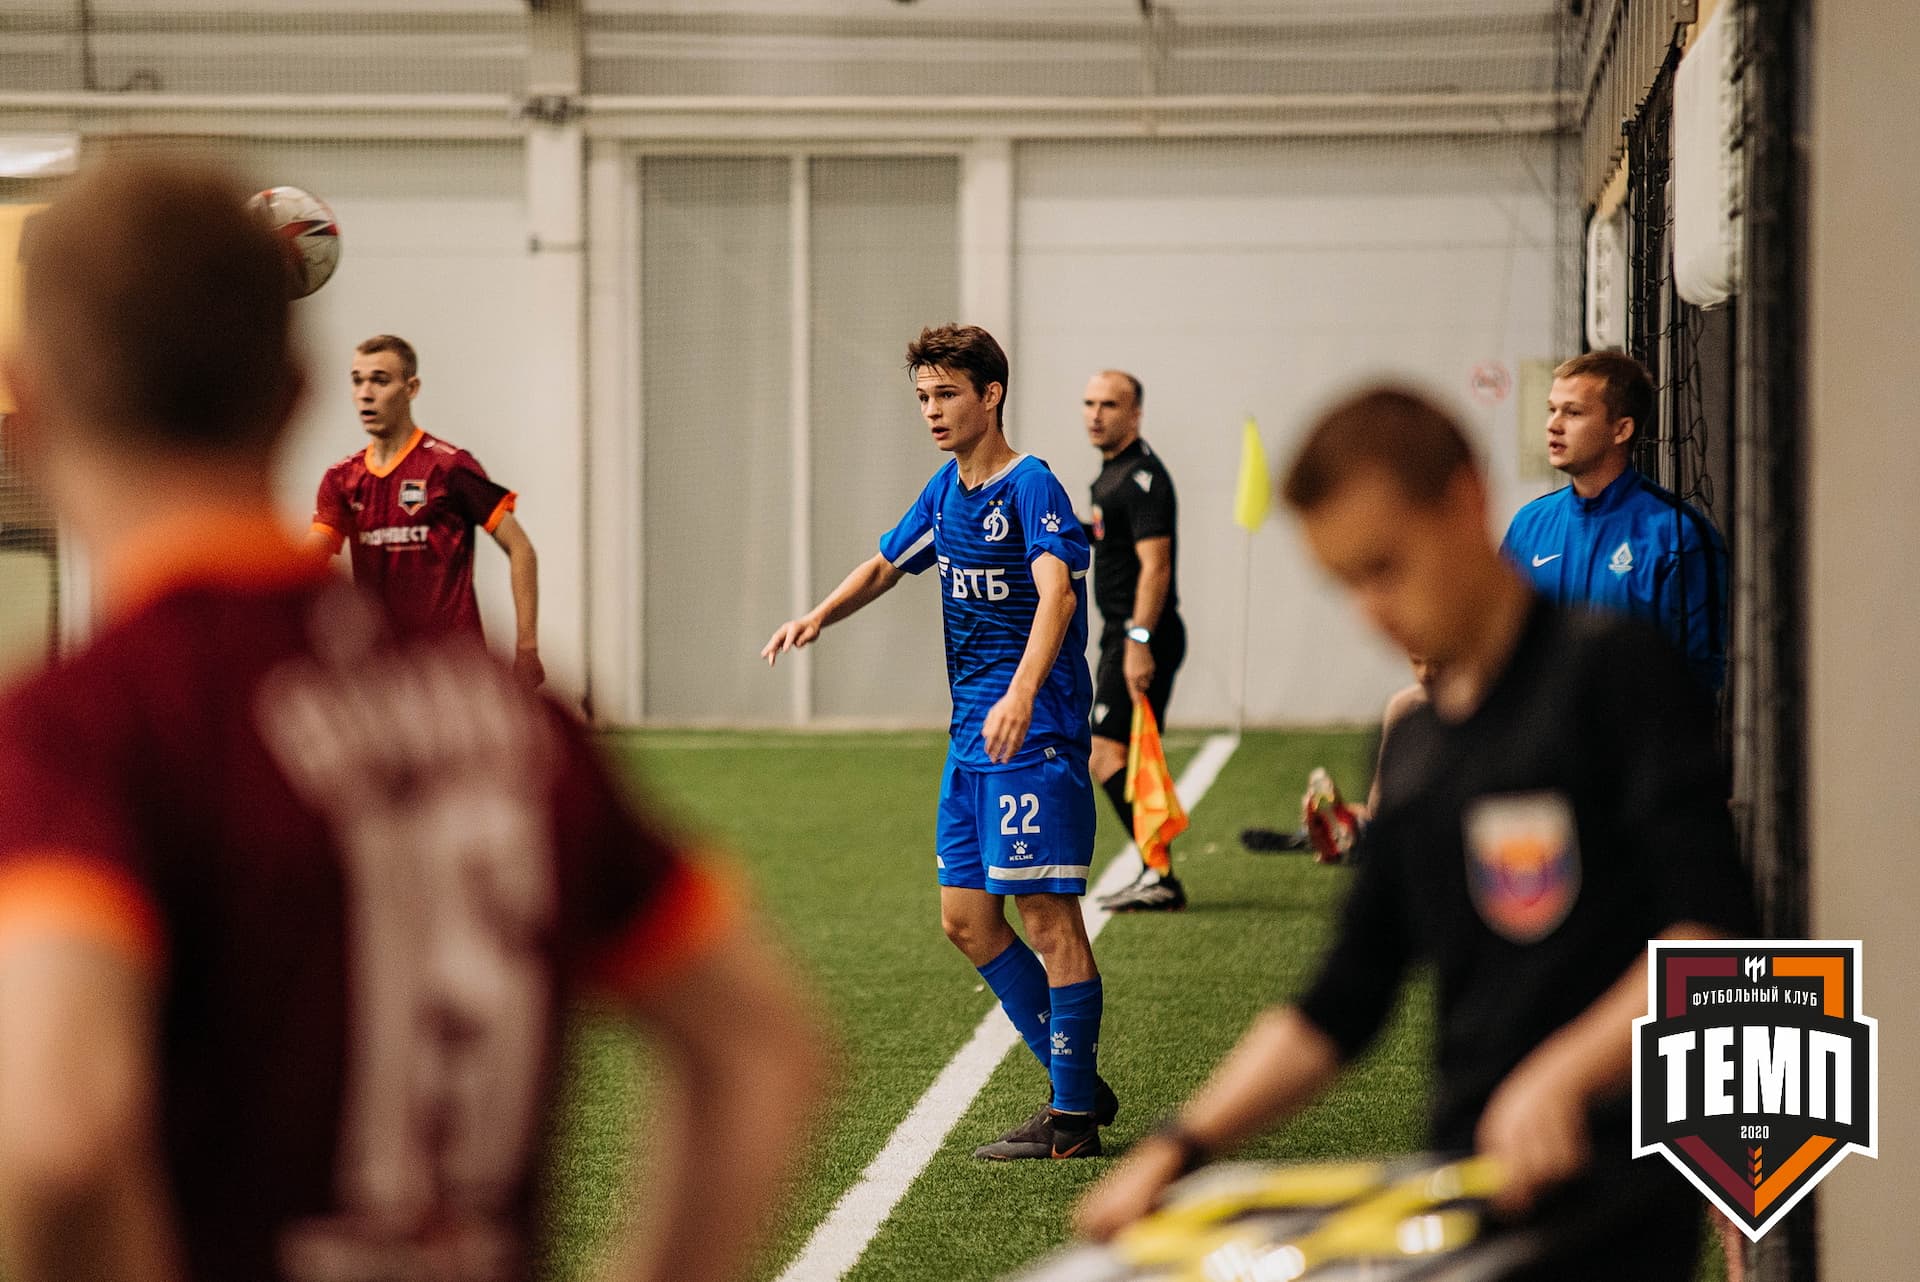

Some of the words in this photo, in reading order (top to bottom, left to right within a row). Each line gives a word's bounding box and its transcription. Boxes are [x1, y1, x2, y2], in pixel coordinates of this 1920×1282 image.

[951, 567, 1010, 601] ВТБ
[999, 793, 1041, 835] 22
[1009, 854, 1034, 862] KELME
